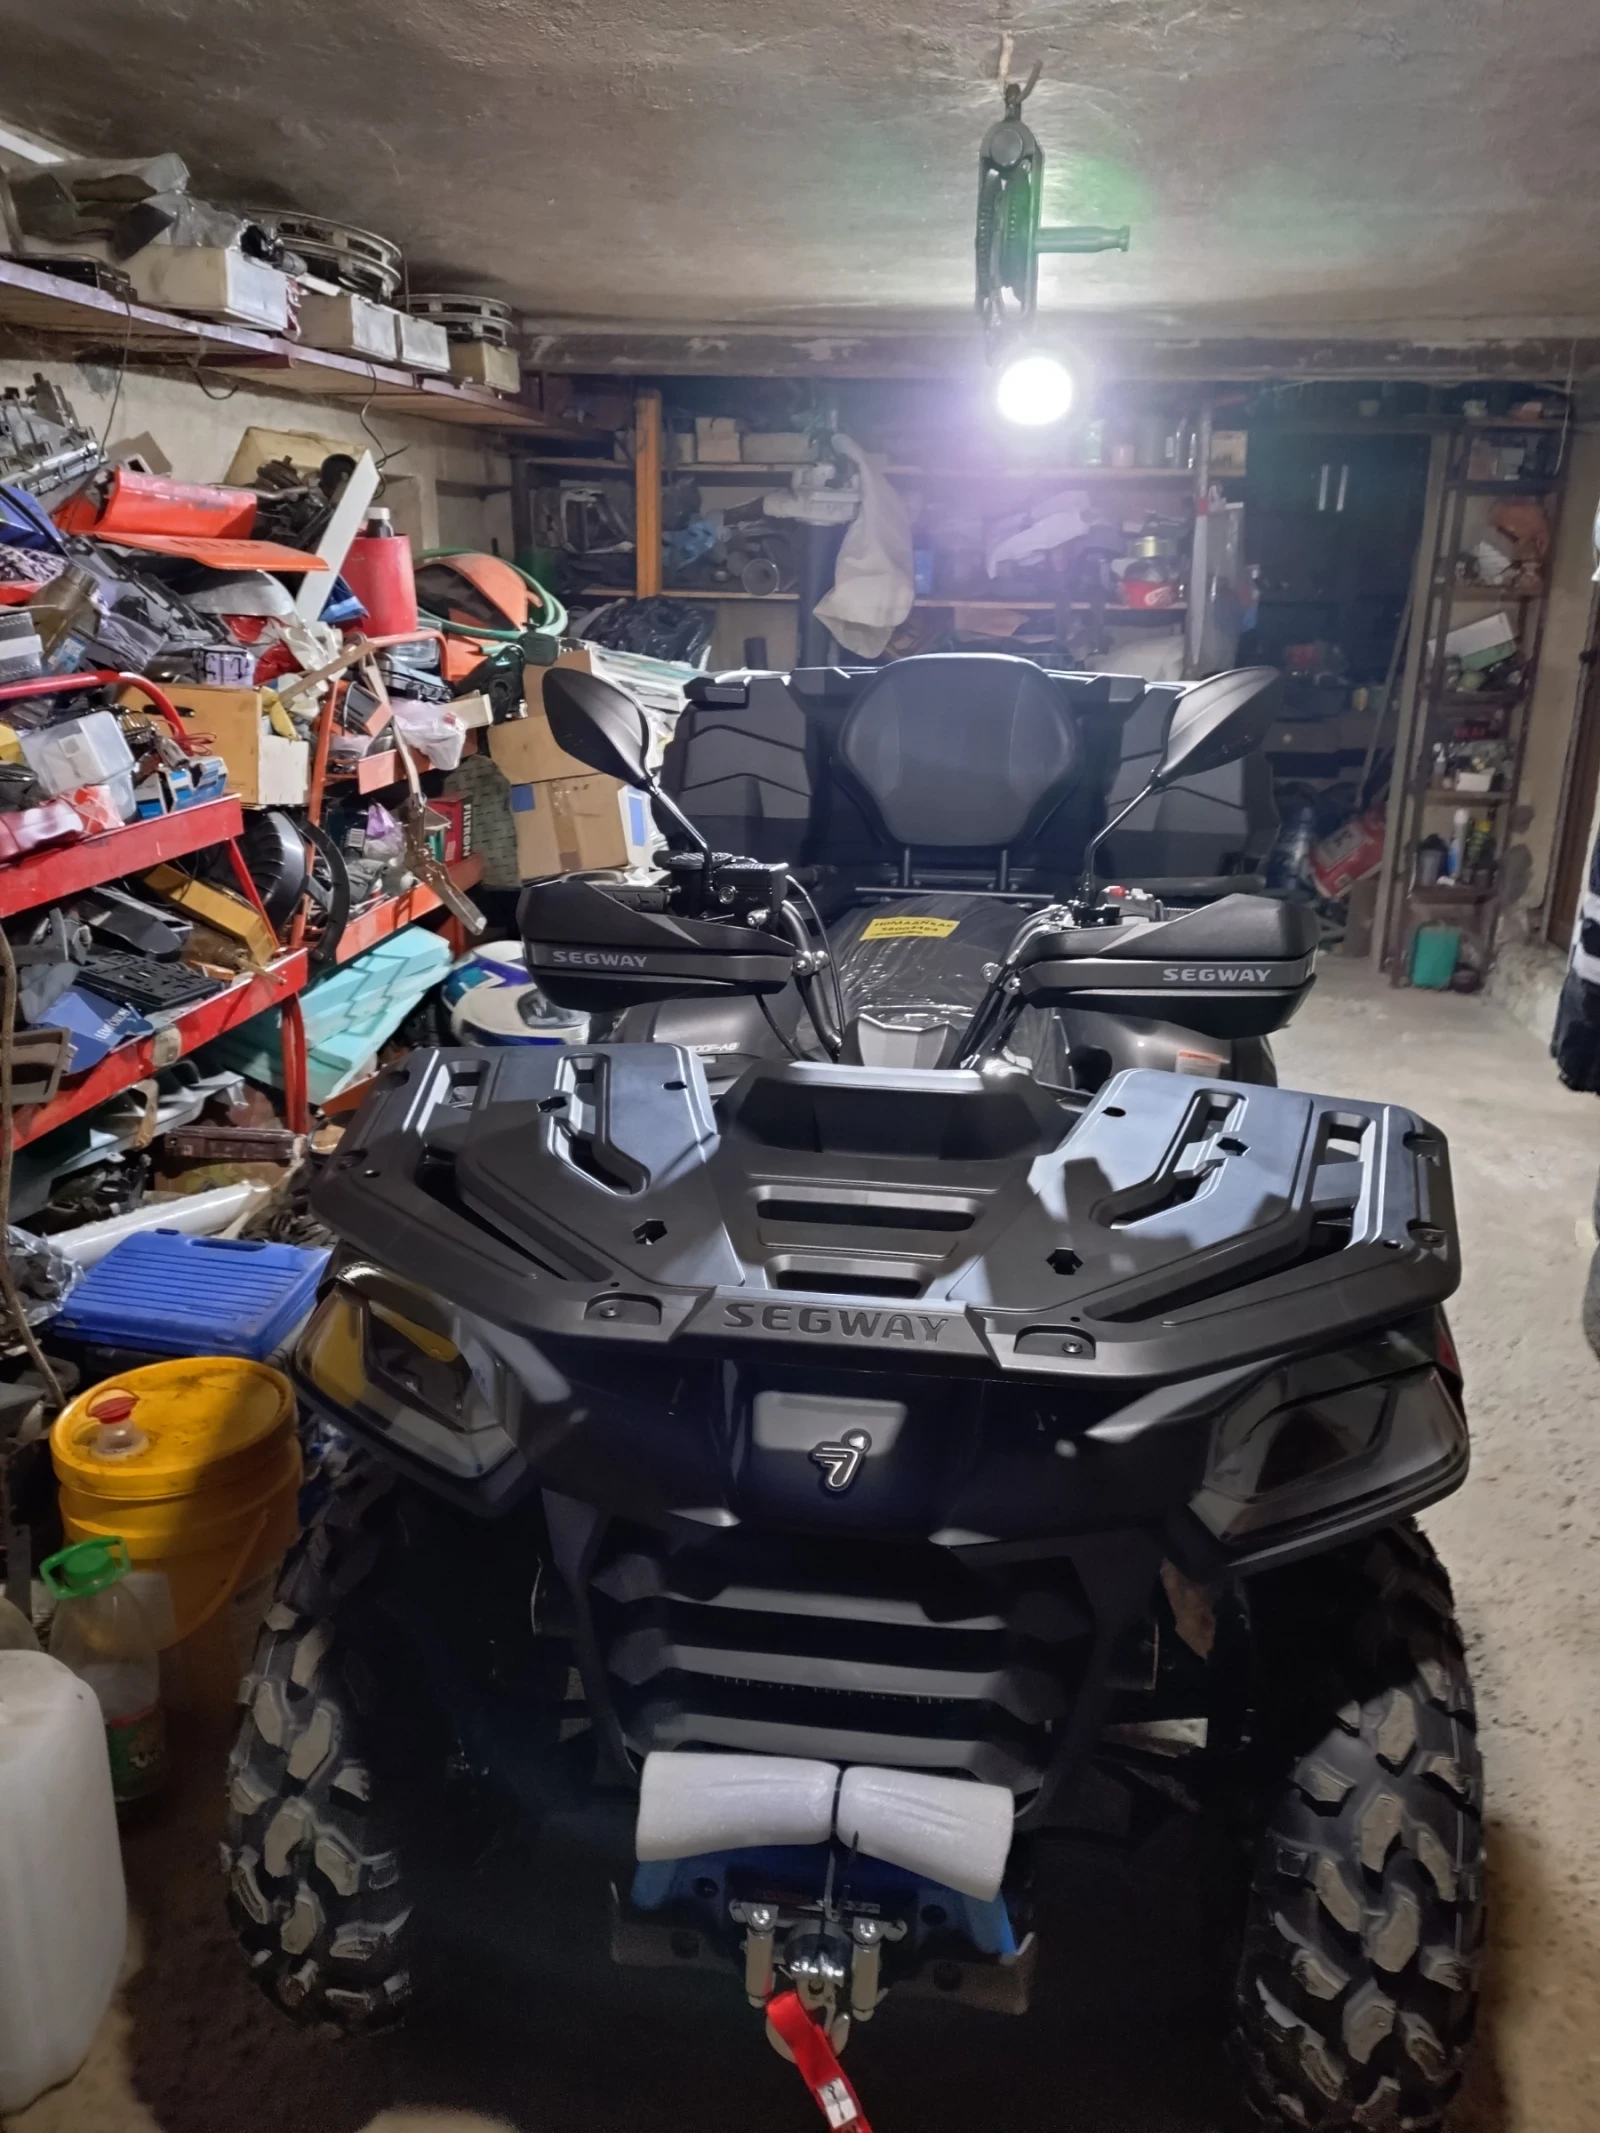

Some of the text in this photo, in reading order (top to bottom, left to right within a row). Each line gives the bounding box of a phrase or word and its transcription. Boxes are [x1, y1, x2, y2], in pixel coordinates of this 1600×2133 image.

[463, 803, 472, 857] FILTRON
[552, 950, 648, 968] SEGWAY
[1162, 968, 1272, 982] SEGWAY
[722, 1303, 949, 1343] SEGWAY
